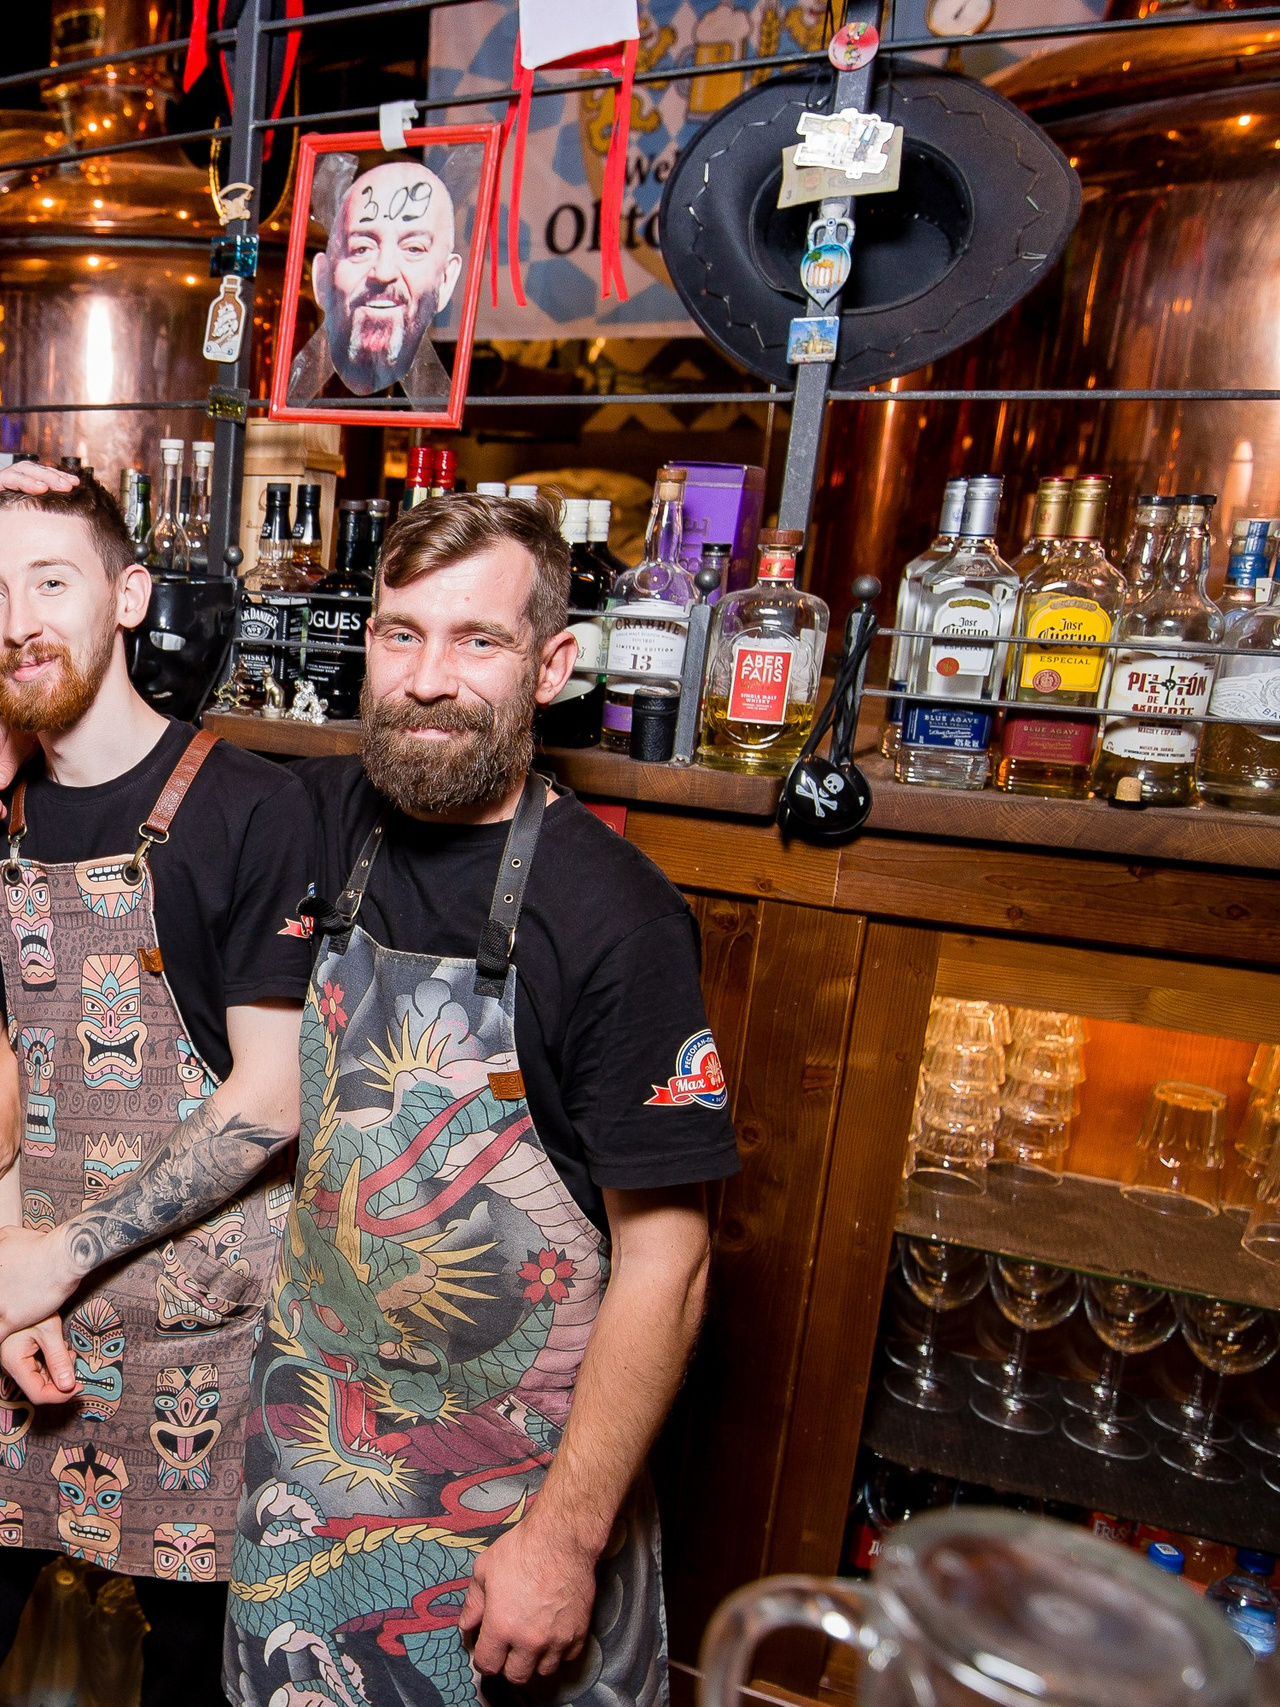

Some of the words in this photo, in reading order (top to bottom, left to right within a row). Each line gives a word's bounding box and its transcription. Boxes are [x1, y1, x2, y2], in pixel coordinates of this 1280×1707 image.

[359, 181, 433, 223] 3.09
[250, 607, 279, 630] DANIEL'S
[308, 610, 361, 631] GUES
[615, 617, 680, 636] CRABBIE
[629, 653, 653, 671] 13
[742, 653, 784, 670] ABER
[1040, 655, 1091, 665] ESPECIAL
[1147, 695, 1159, 704] DE
[1174, 698, 1186, 706] LA
[1262, 707, 1280, 720] BA
[1050, 728, 1080, 736] AGAVE
[675, 1078, 707, 1093] Max
